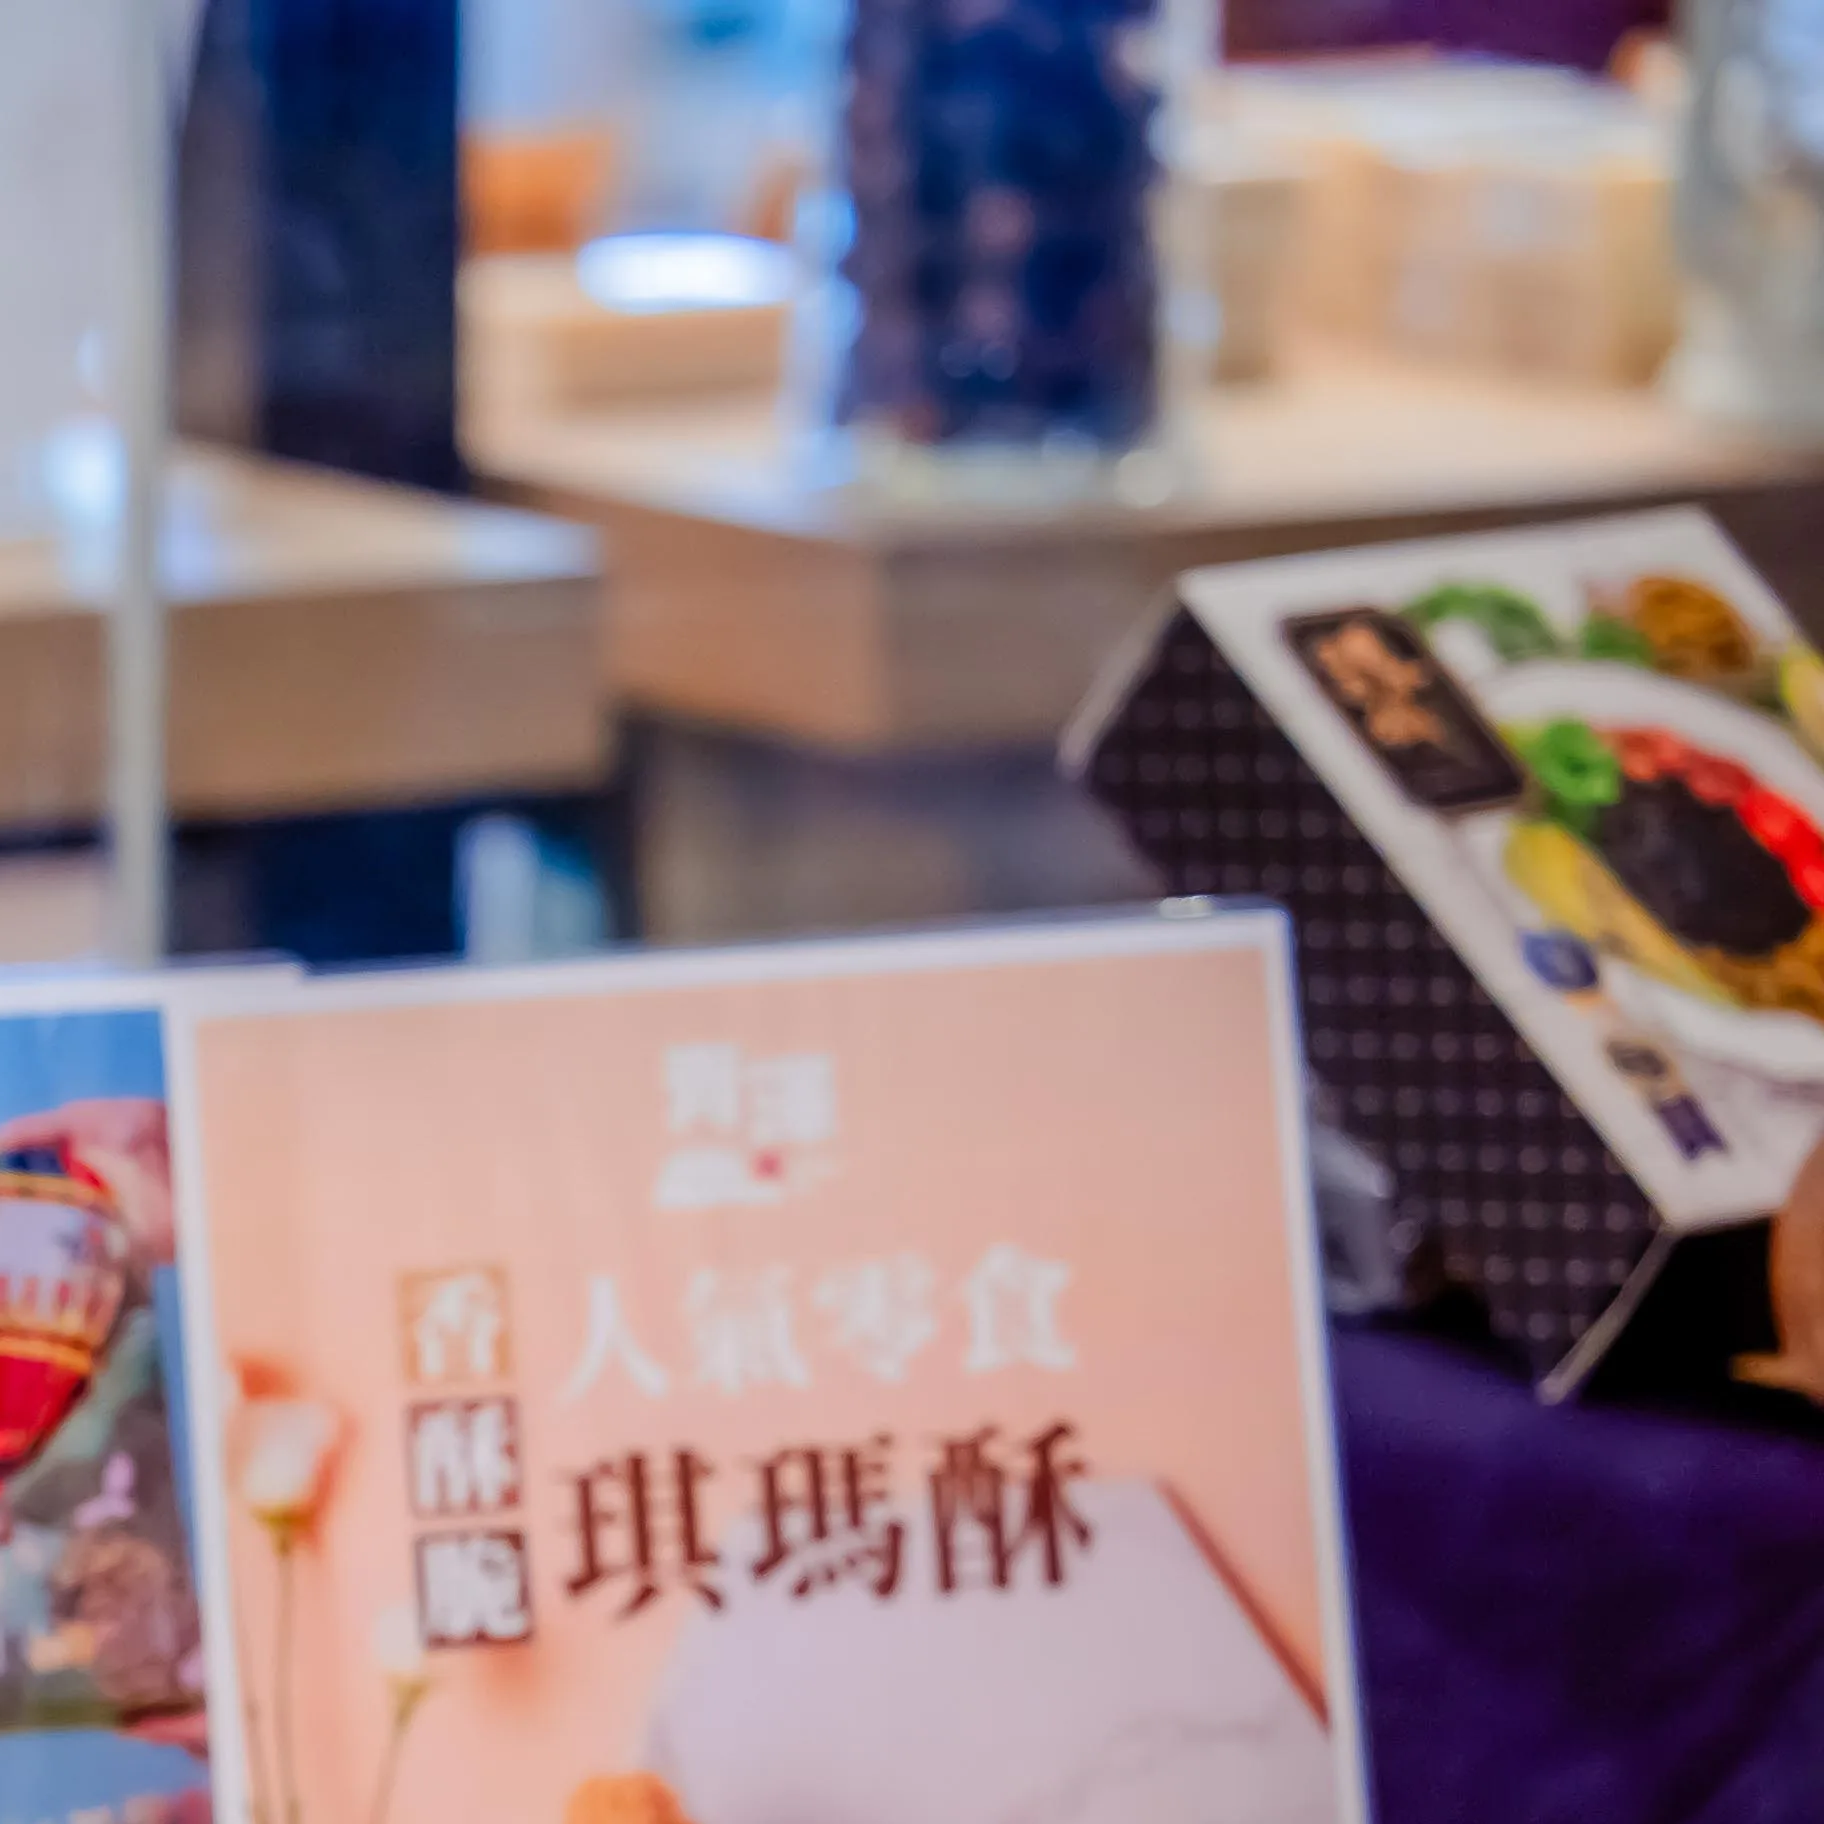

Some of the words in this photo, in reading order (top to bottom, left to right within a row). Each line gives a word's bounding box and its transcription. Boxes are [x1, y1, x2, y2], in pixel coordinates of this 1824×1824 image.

[563, 1239, 1078, 1395] 人氣零食
[562, 1420, 1096, 1621] 琪瑪酥
